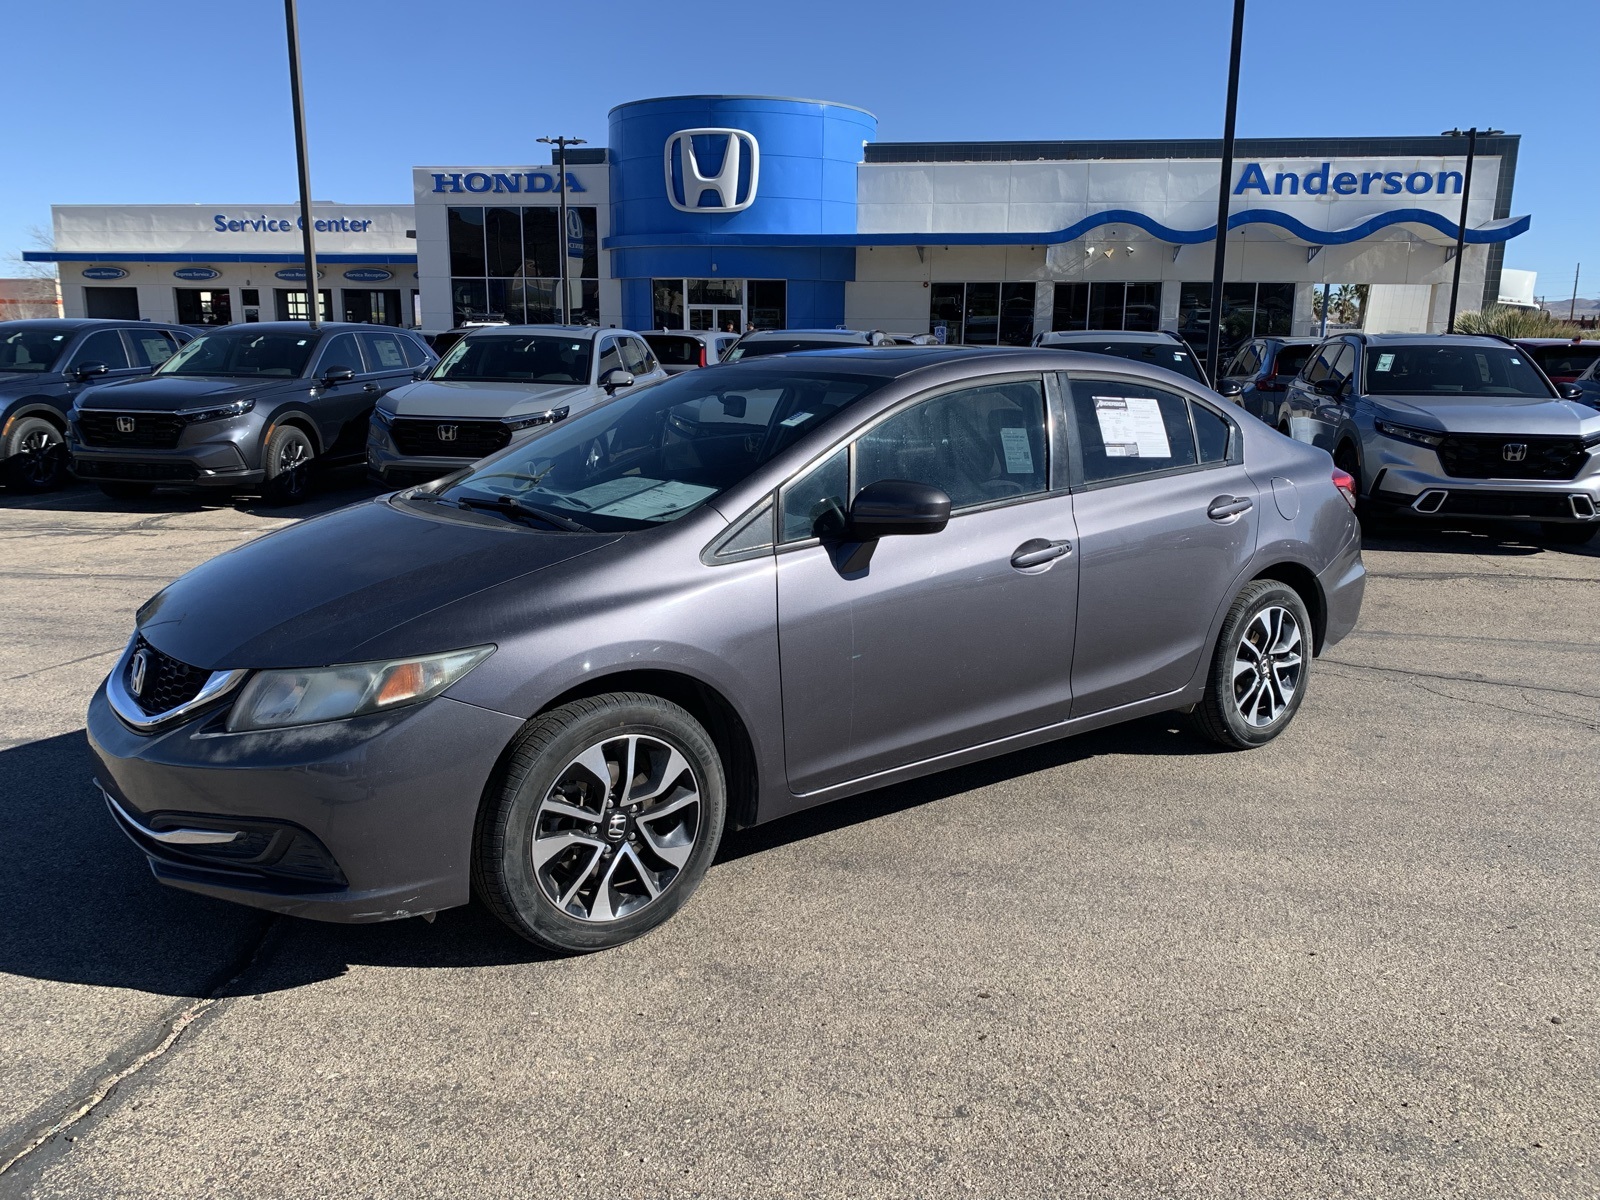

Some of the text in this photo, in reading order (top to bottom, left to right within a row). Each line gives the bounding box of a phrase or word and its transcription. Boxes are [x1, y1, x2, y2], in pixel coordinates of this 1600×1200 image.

[431, 172, 586, 193] HONDA
[1233, 162, 1464, 195] Anderson
[214, 214, 291, 232] Service
